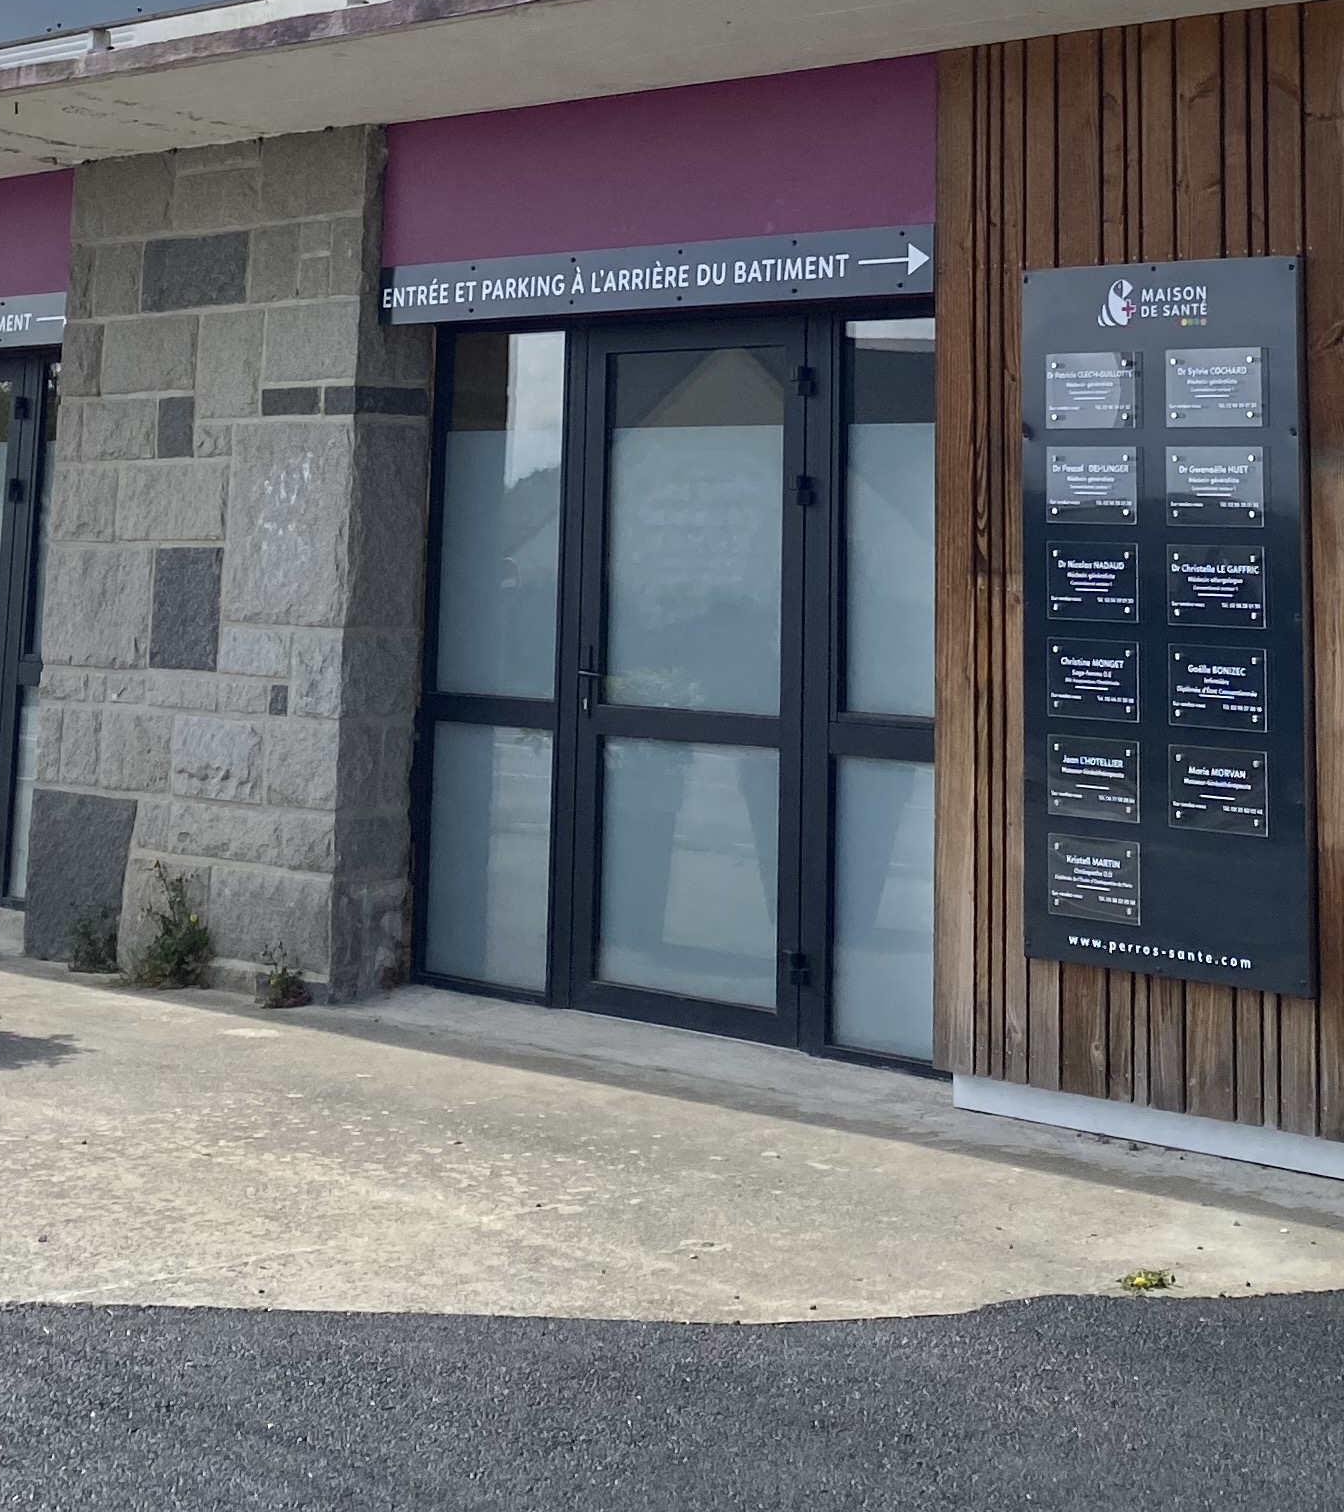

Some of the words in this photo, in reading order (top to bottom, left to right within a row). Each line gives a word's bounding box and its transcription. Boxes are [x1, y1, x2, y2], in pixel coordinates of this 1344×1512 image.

[382, 278, 449, 309] ENTRÉE
[454, 280, 477, 303] ET
[481, 274, 565, 301] PARKING
[571, 266, 585, 295] À
[696, 262, 727, 286] DU
[734, 253, 850, 284] BATIMENT
[1141, 285, 1207, 303] MAISON
[1141, 305, 1159, 318] DE
[1162, 299, 1208, 317] SANTÉ
[1216, 564, 1226, 574] LE
[1068, 935, 1252, 970] www.perros-sante.com
